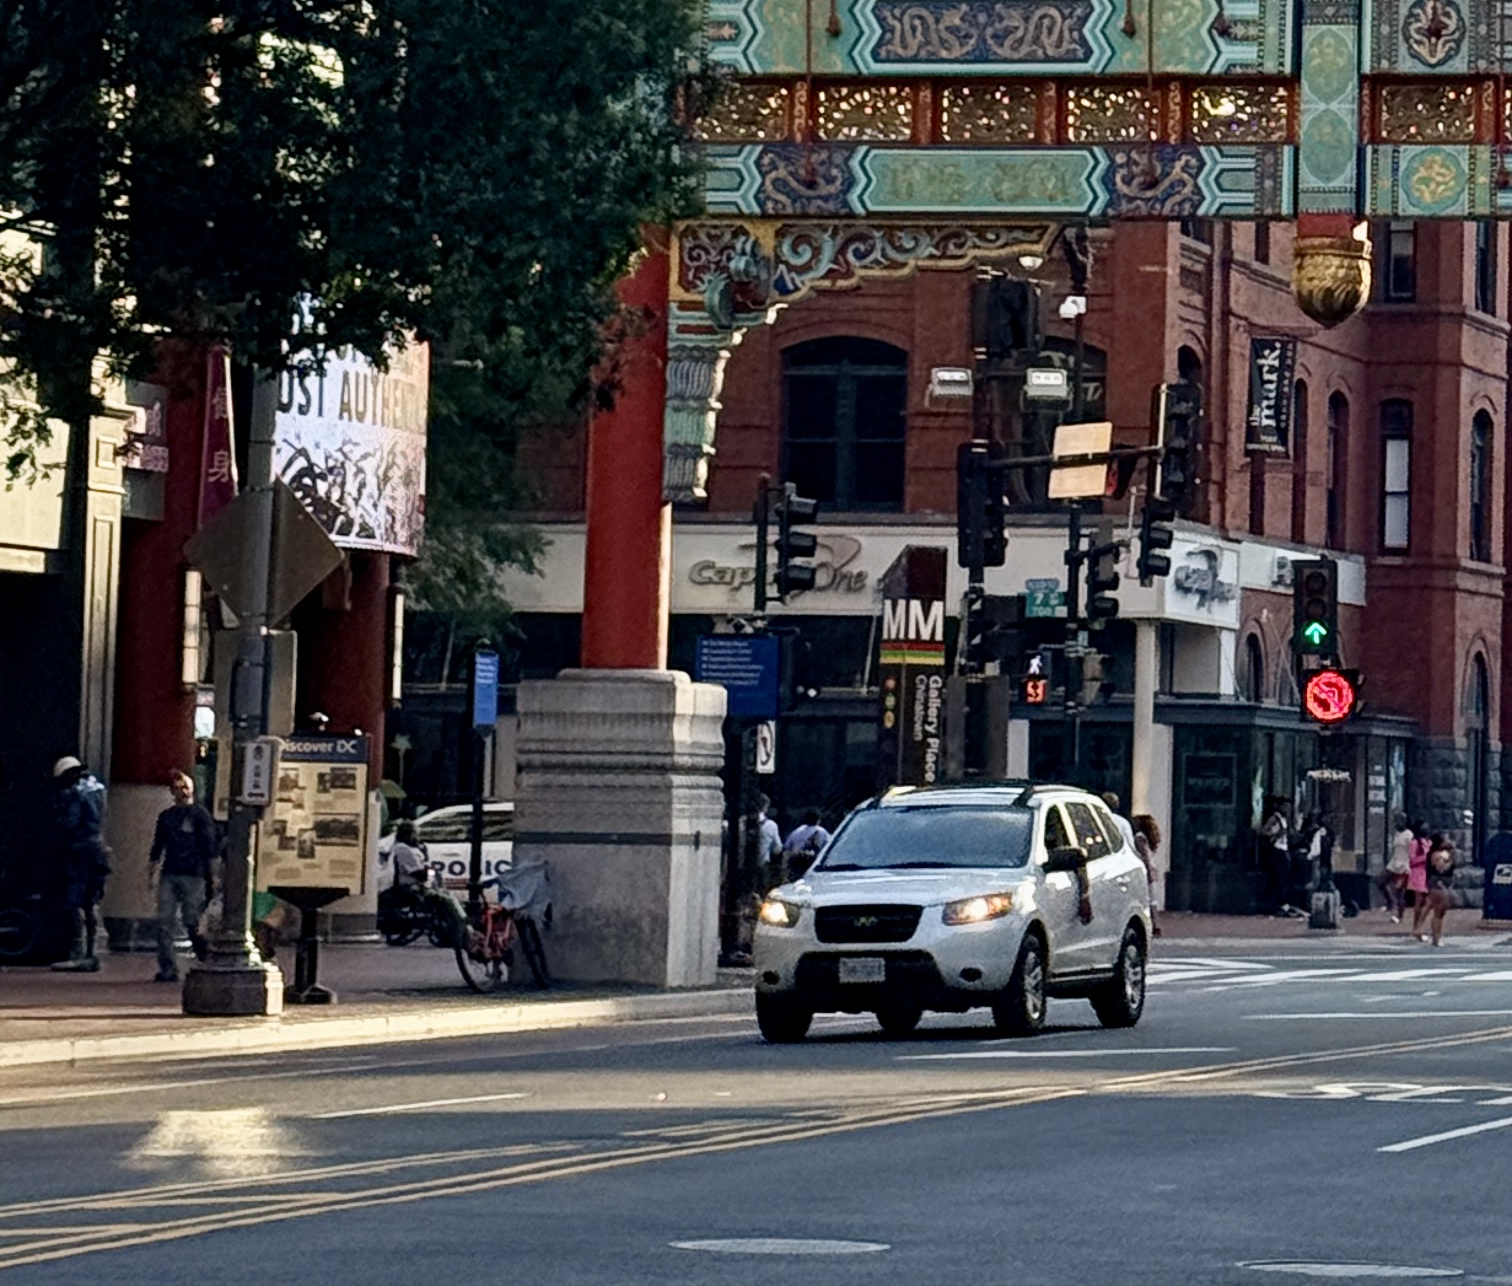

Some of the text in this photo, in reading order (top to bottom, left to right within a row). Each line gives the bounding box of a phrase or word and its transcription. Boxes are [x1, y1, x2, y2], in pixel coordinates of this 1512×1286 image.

[279, 364, 324, 418] UST
[913, 674, 927, 741] Chinatown
[924, 675, 943, 783] Gallery Place
[284, 738, 359, 754] iscover DC
[431, 859, 513, 876] POIC
